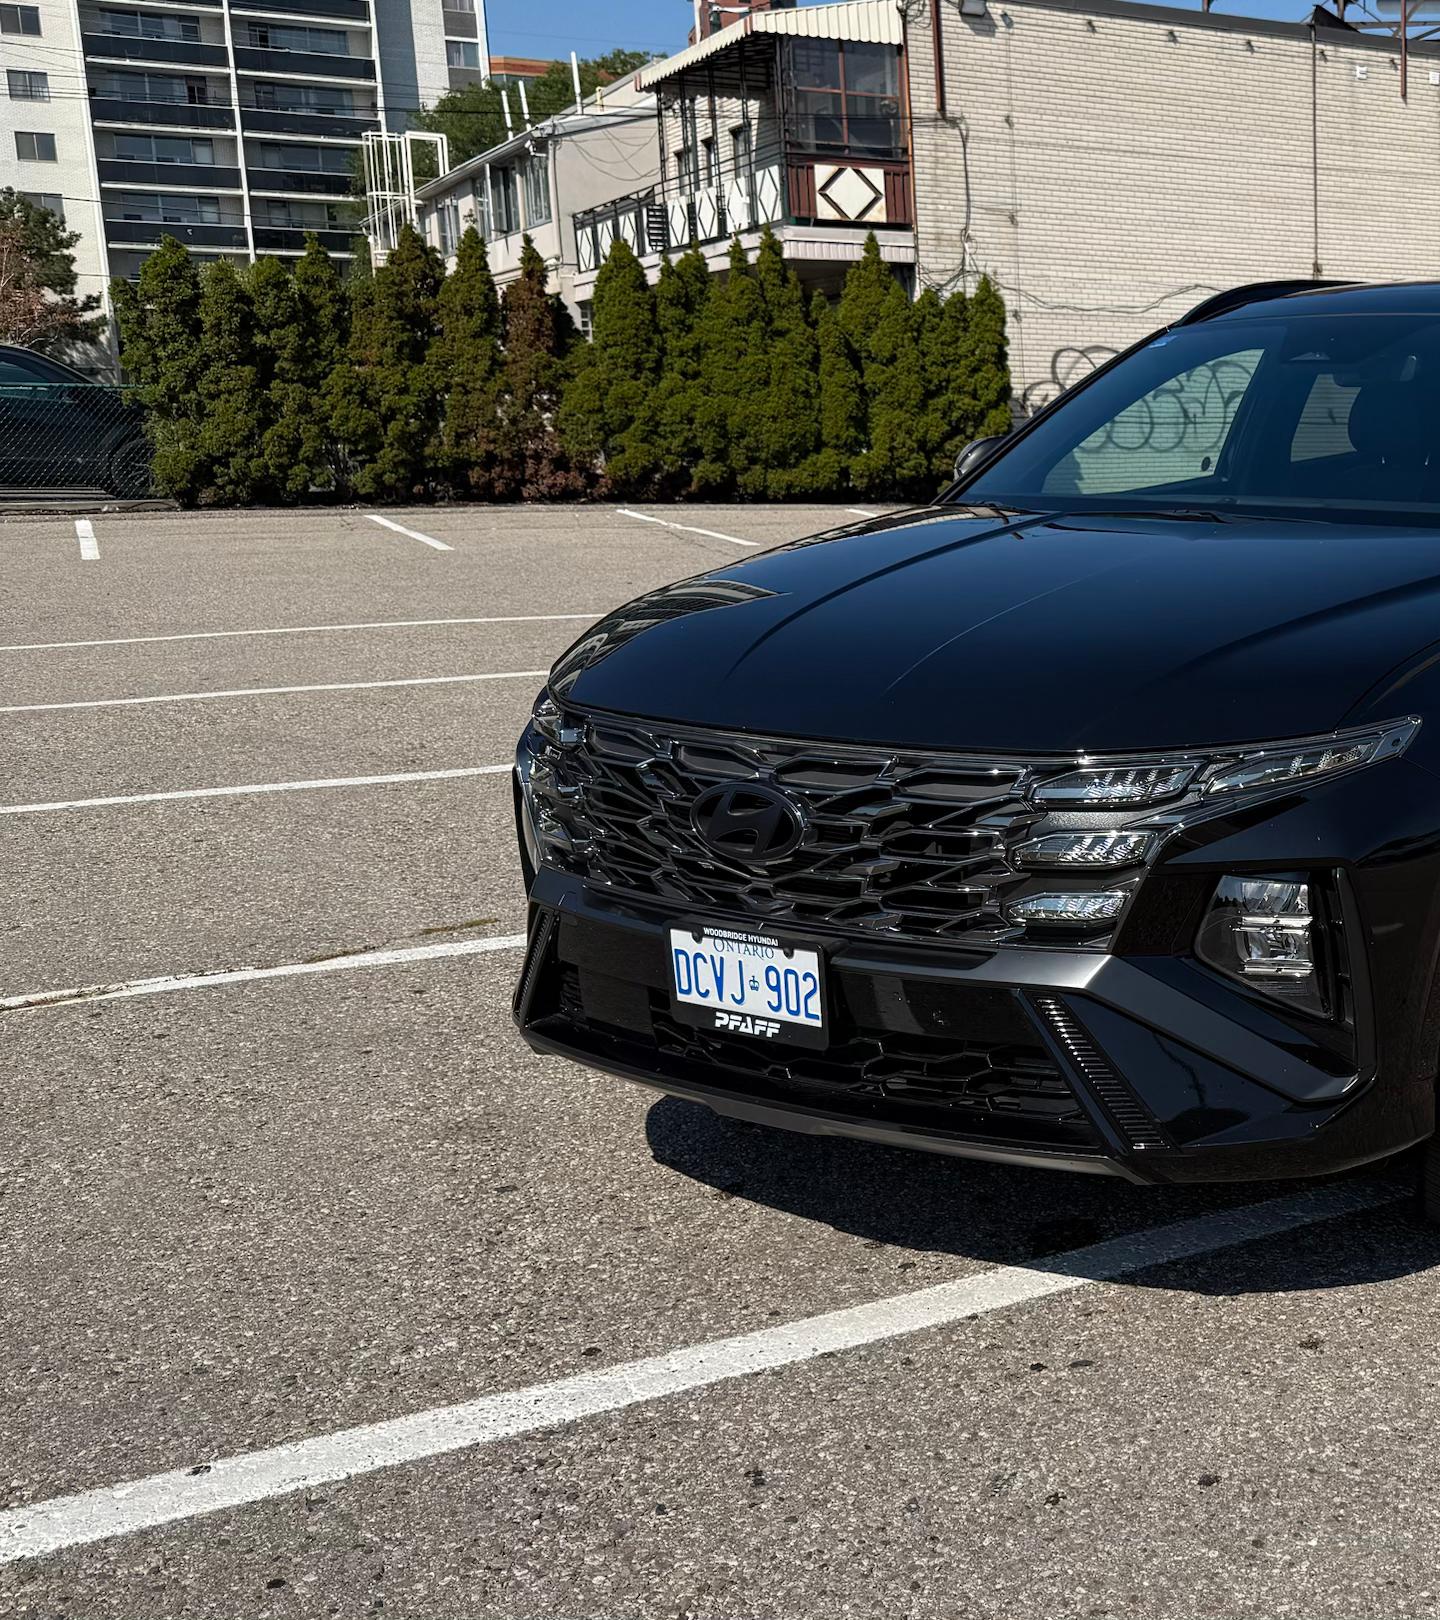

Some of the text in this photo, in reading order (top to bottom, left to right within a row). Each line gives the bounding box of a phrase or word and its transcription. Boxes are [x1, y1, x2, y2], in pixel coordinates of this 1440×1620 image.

[703, 927, 779, 947] WOODBRIDGE HYUNDAI
[713, 939, 774, 960] ONTARIO
[714, 1011, 781, 1039] PFAFF
